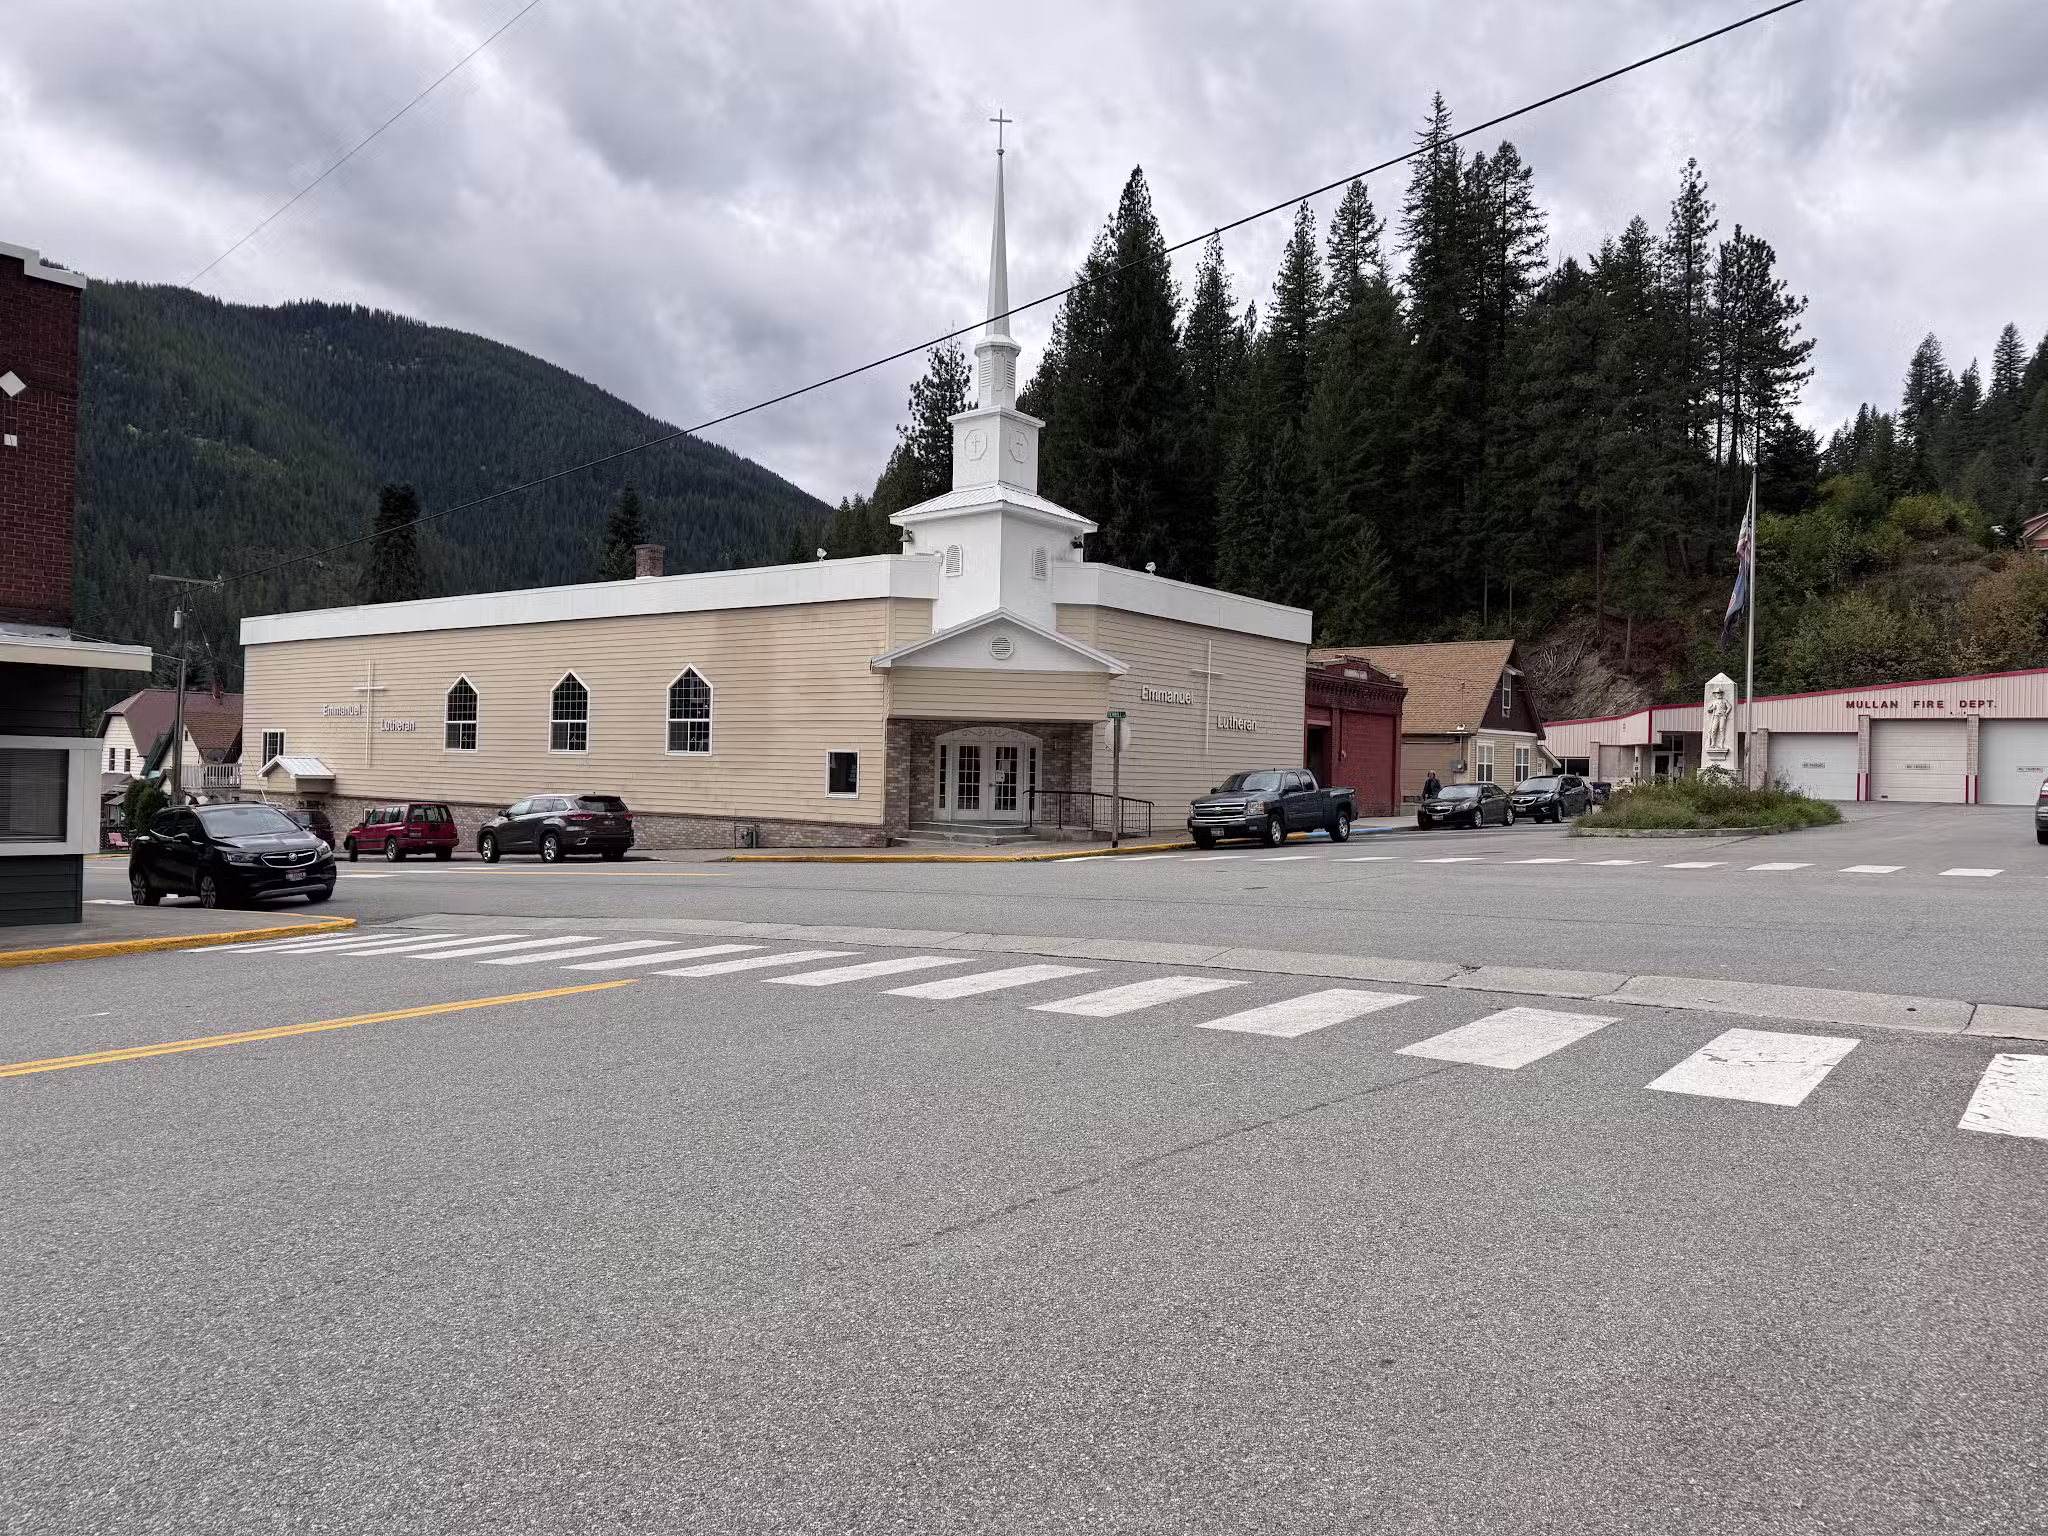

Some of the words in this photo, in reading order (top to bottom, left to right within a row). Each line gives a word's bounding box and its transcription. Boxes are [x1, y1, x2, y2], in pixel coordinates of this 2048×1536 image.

[1141, 685, 1194, 705] Emmanuel
[323, 704, 362, 716] Emmanuel
[1846, 700, 1899, 709] MULLAN
[1913, 700, 1945, 709] FIRE
[1959, 700, 1997, 708] DEPT.
[381, 719, 416, 731] Lutheran
[1217, 713, 1257, 732] Lutheran
